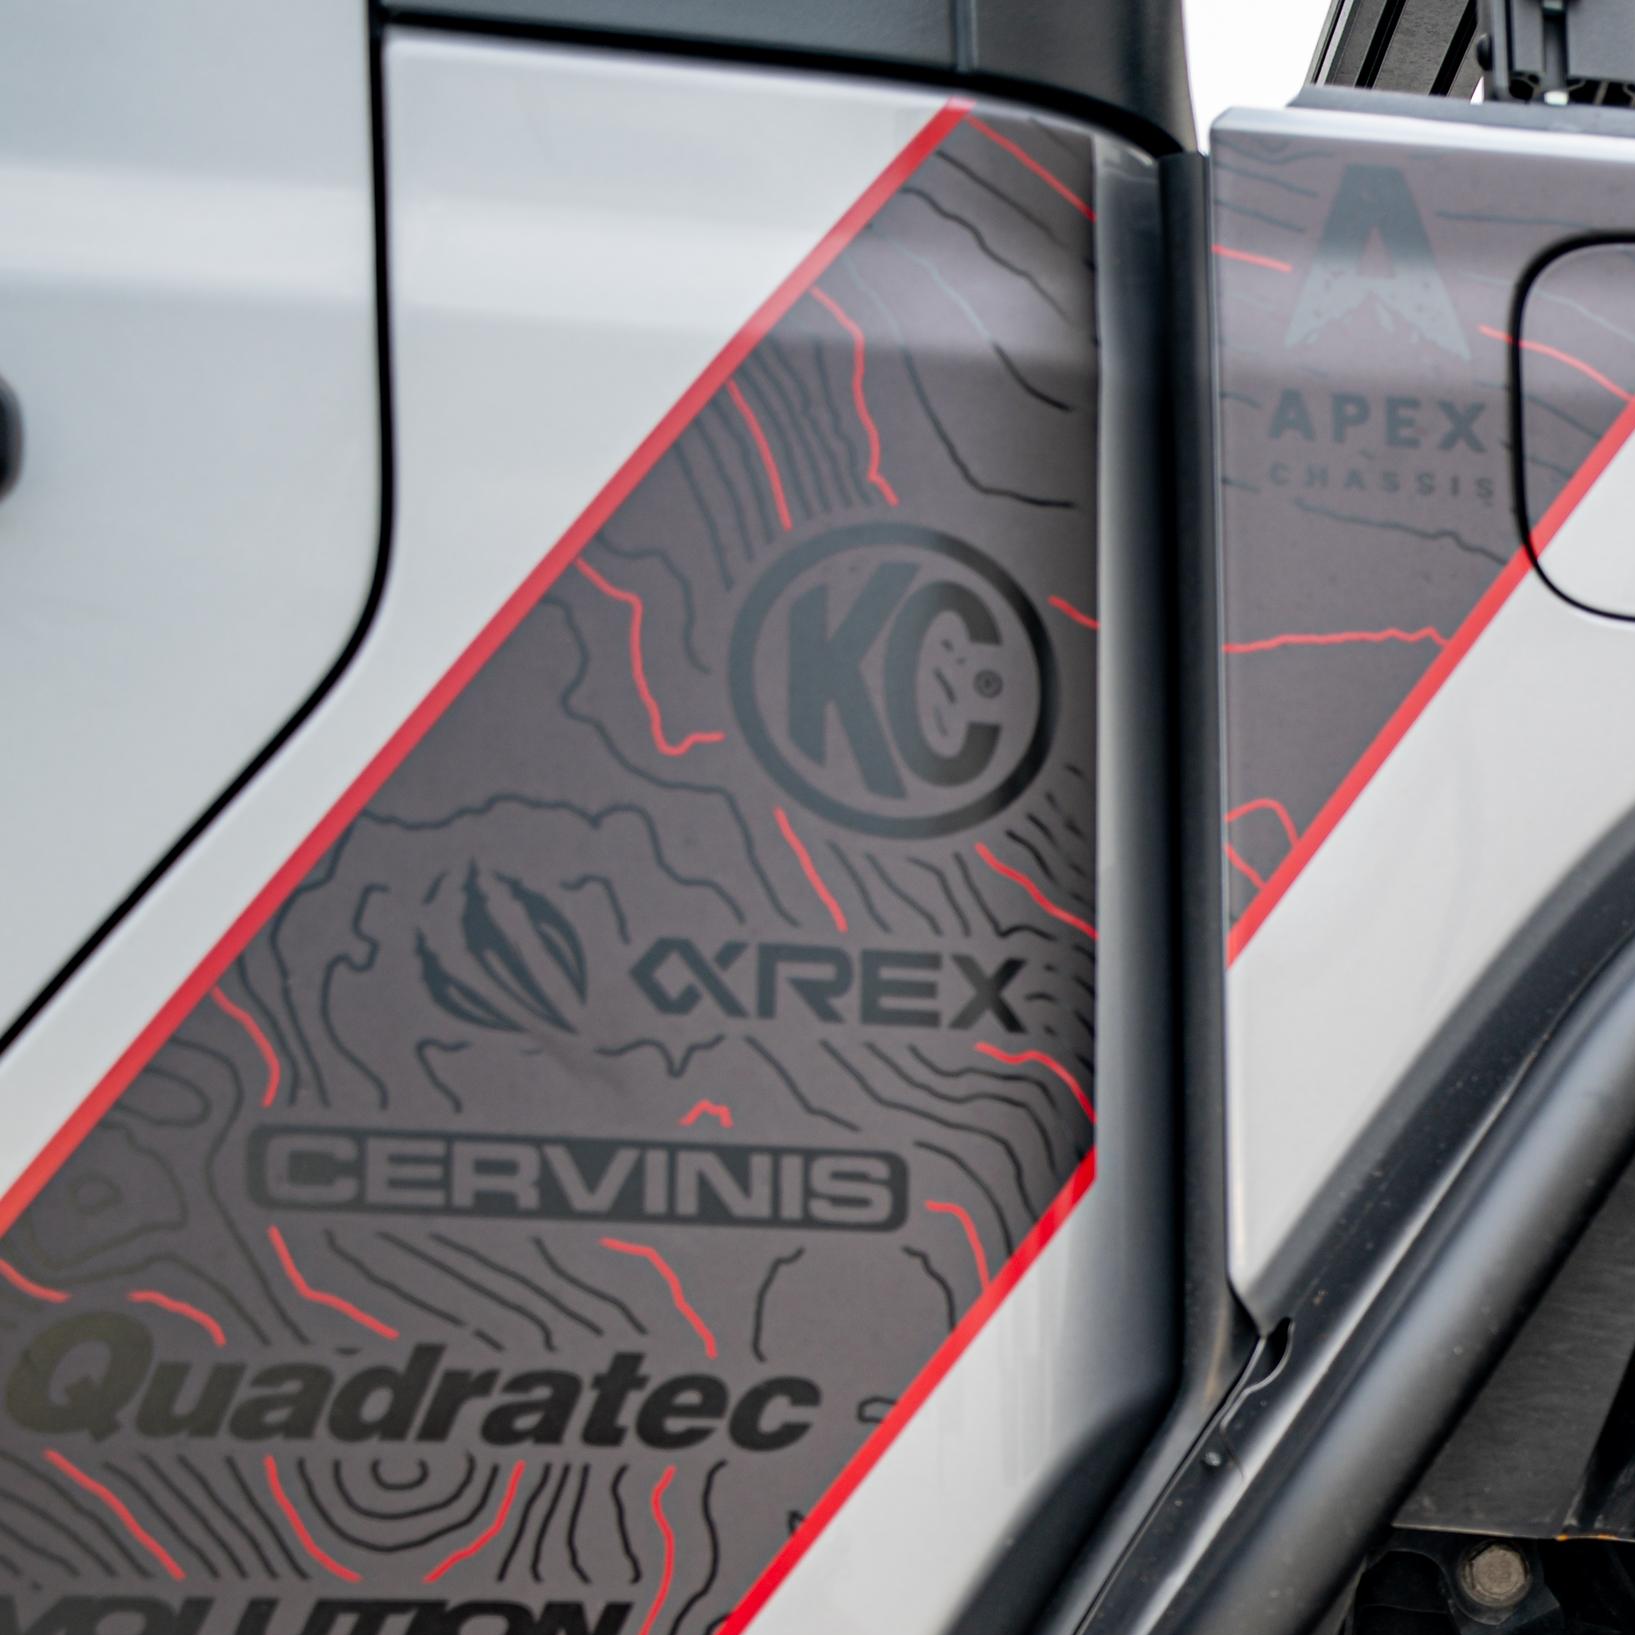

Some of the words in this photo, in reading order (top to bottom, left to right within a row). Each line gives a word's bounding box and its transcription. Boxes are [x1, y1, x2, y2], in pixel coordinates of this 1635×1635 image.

[1267, 389, 1489, 454] APEX
[1269, 461, 1495, 500] CHASSIS
[260, 1138, 880, 1225] CERVINIS
[4, 1310, 822, 1452] Quadratec
